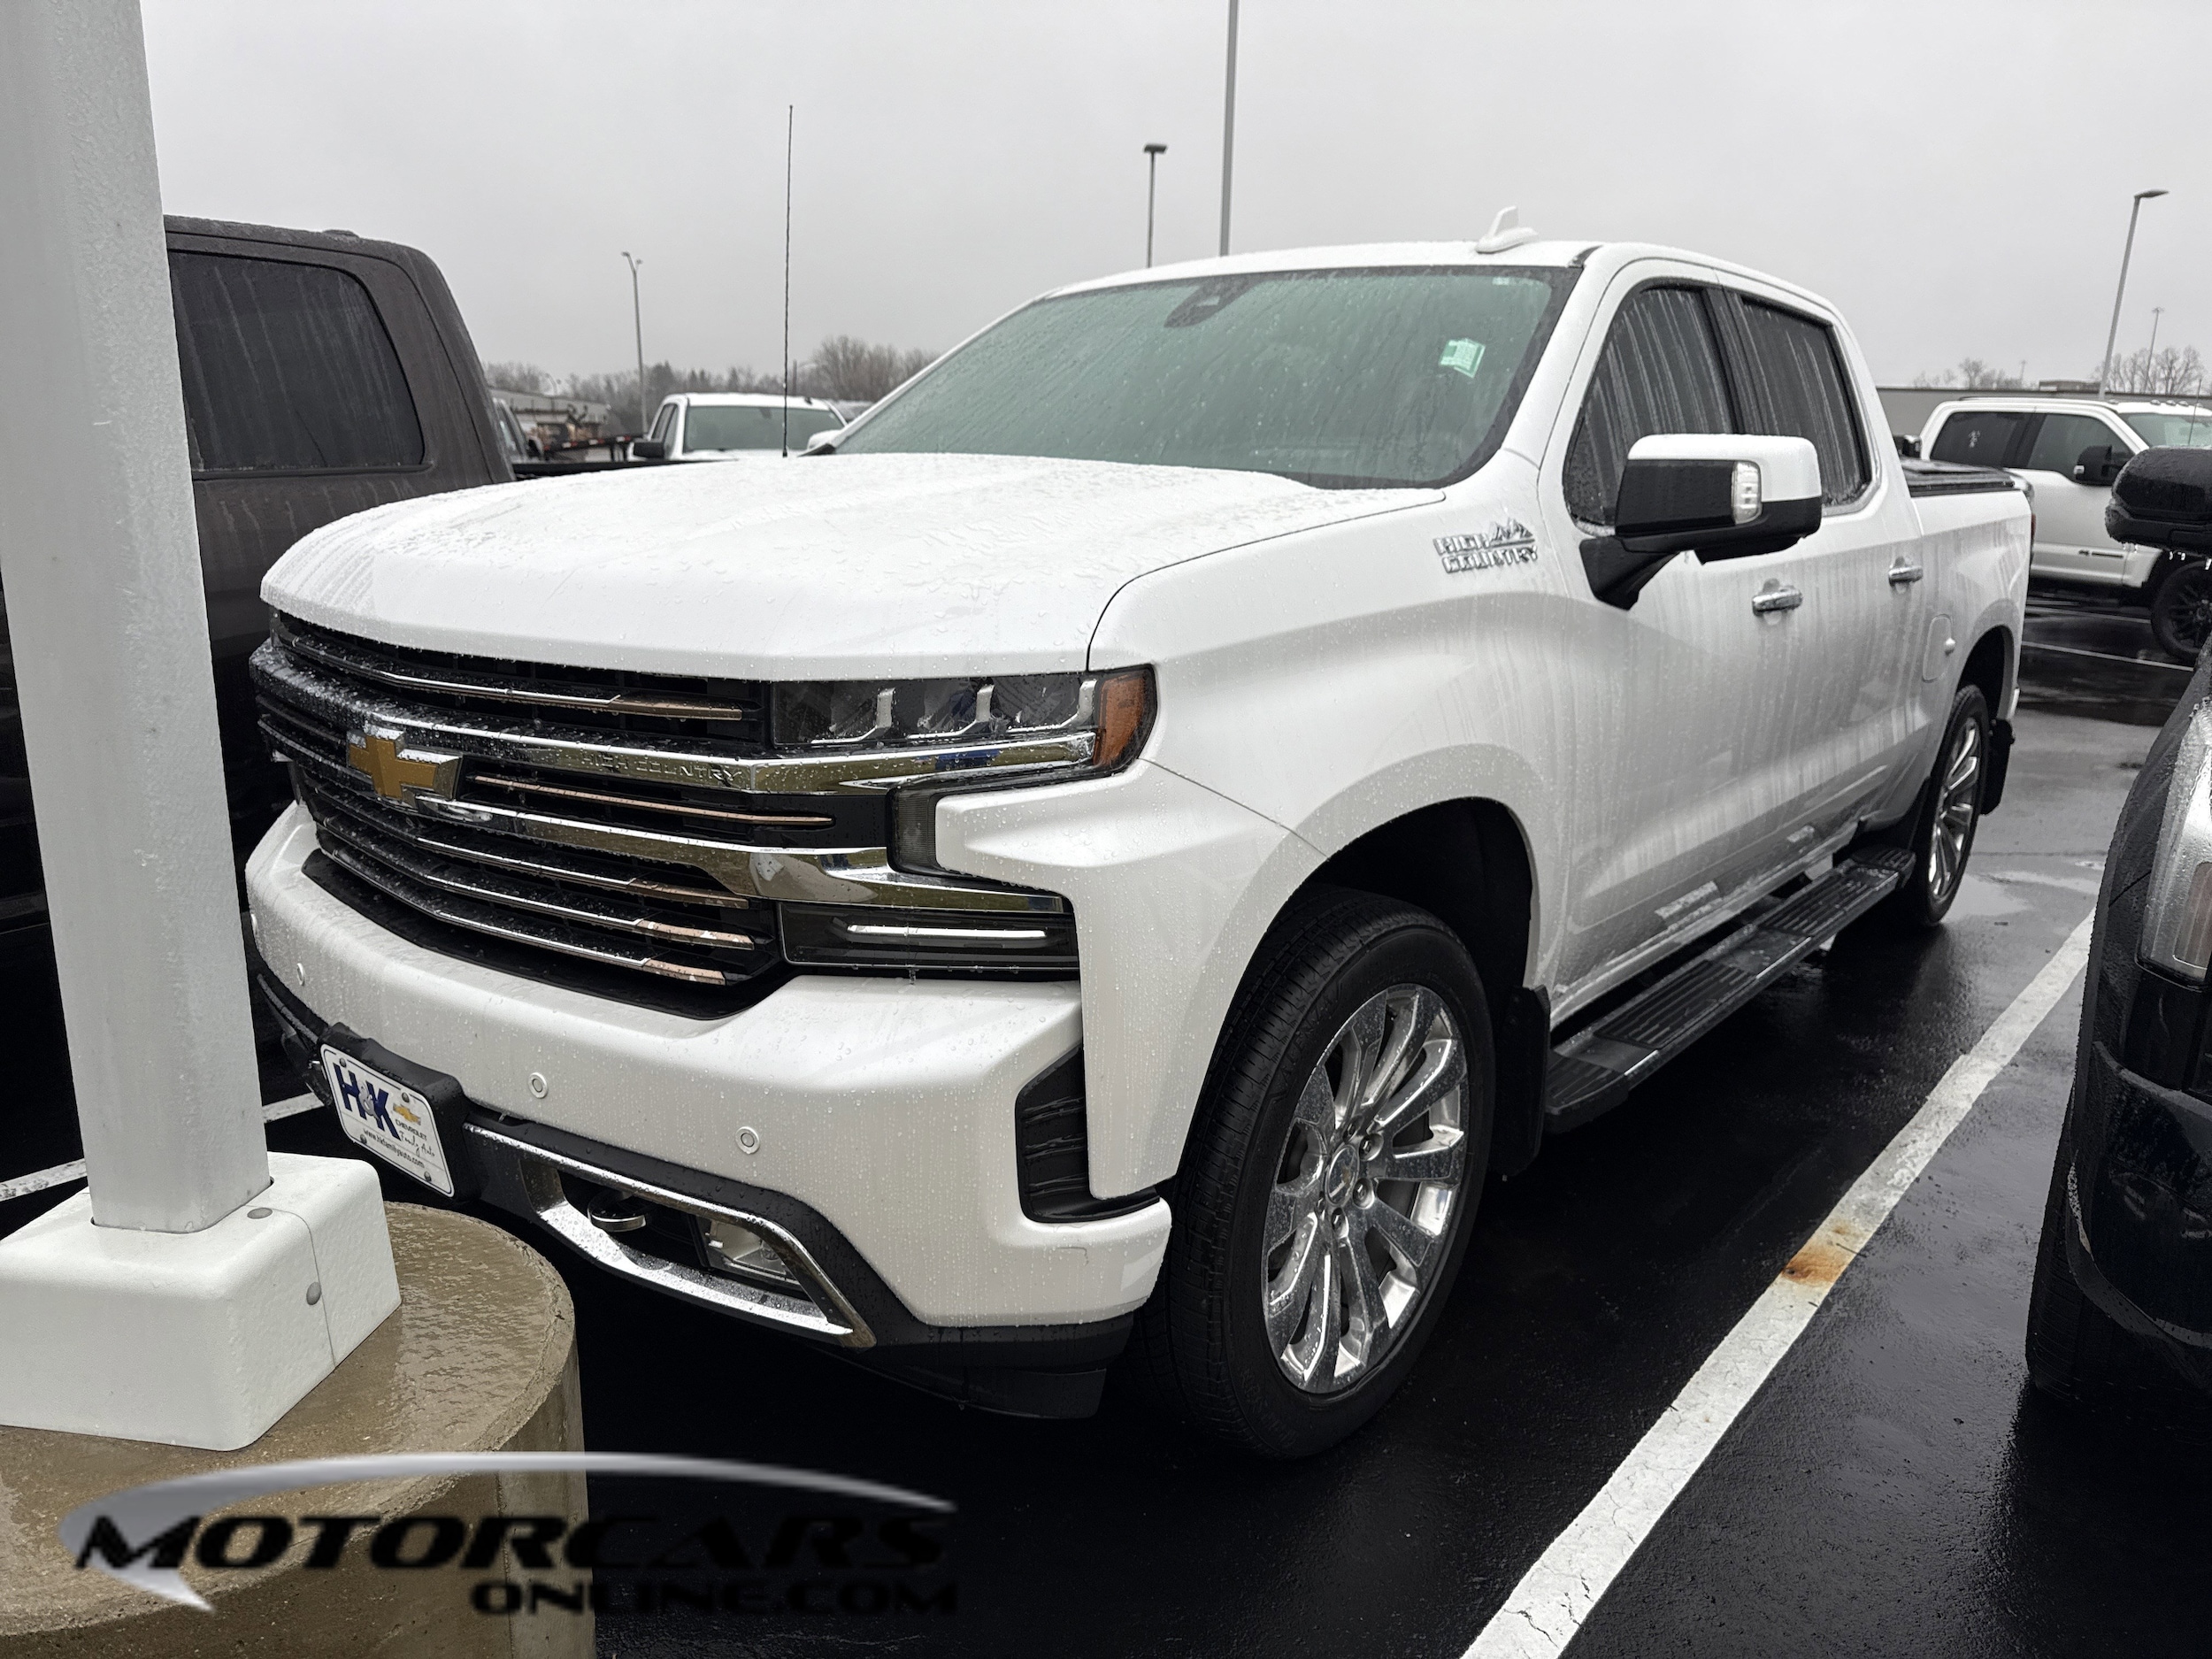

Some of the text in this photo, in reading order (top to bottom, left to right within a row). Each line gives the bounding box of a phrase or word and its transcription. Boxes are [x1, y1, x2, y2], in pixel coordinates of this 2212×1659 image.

[1433, 534, 1491, 556] HIGH
[1442, 546, 1538, 573] COUNTRY
[581, 750, 743, 781] HIGH COUNTRY
[334, 1064, 401, 1141] H&K
[396, 1119, 426, 1141] CHEVROLET
